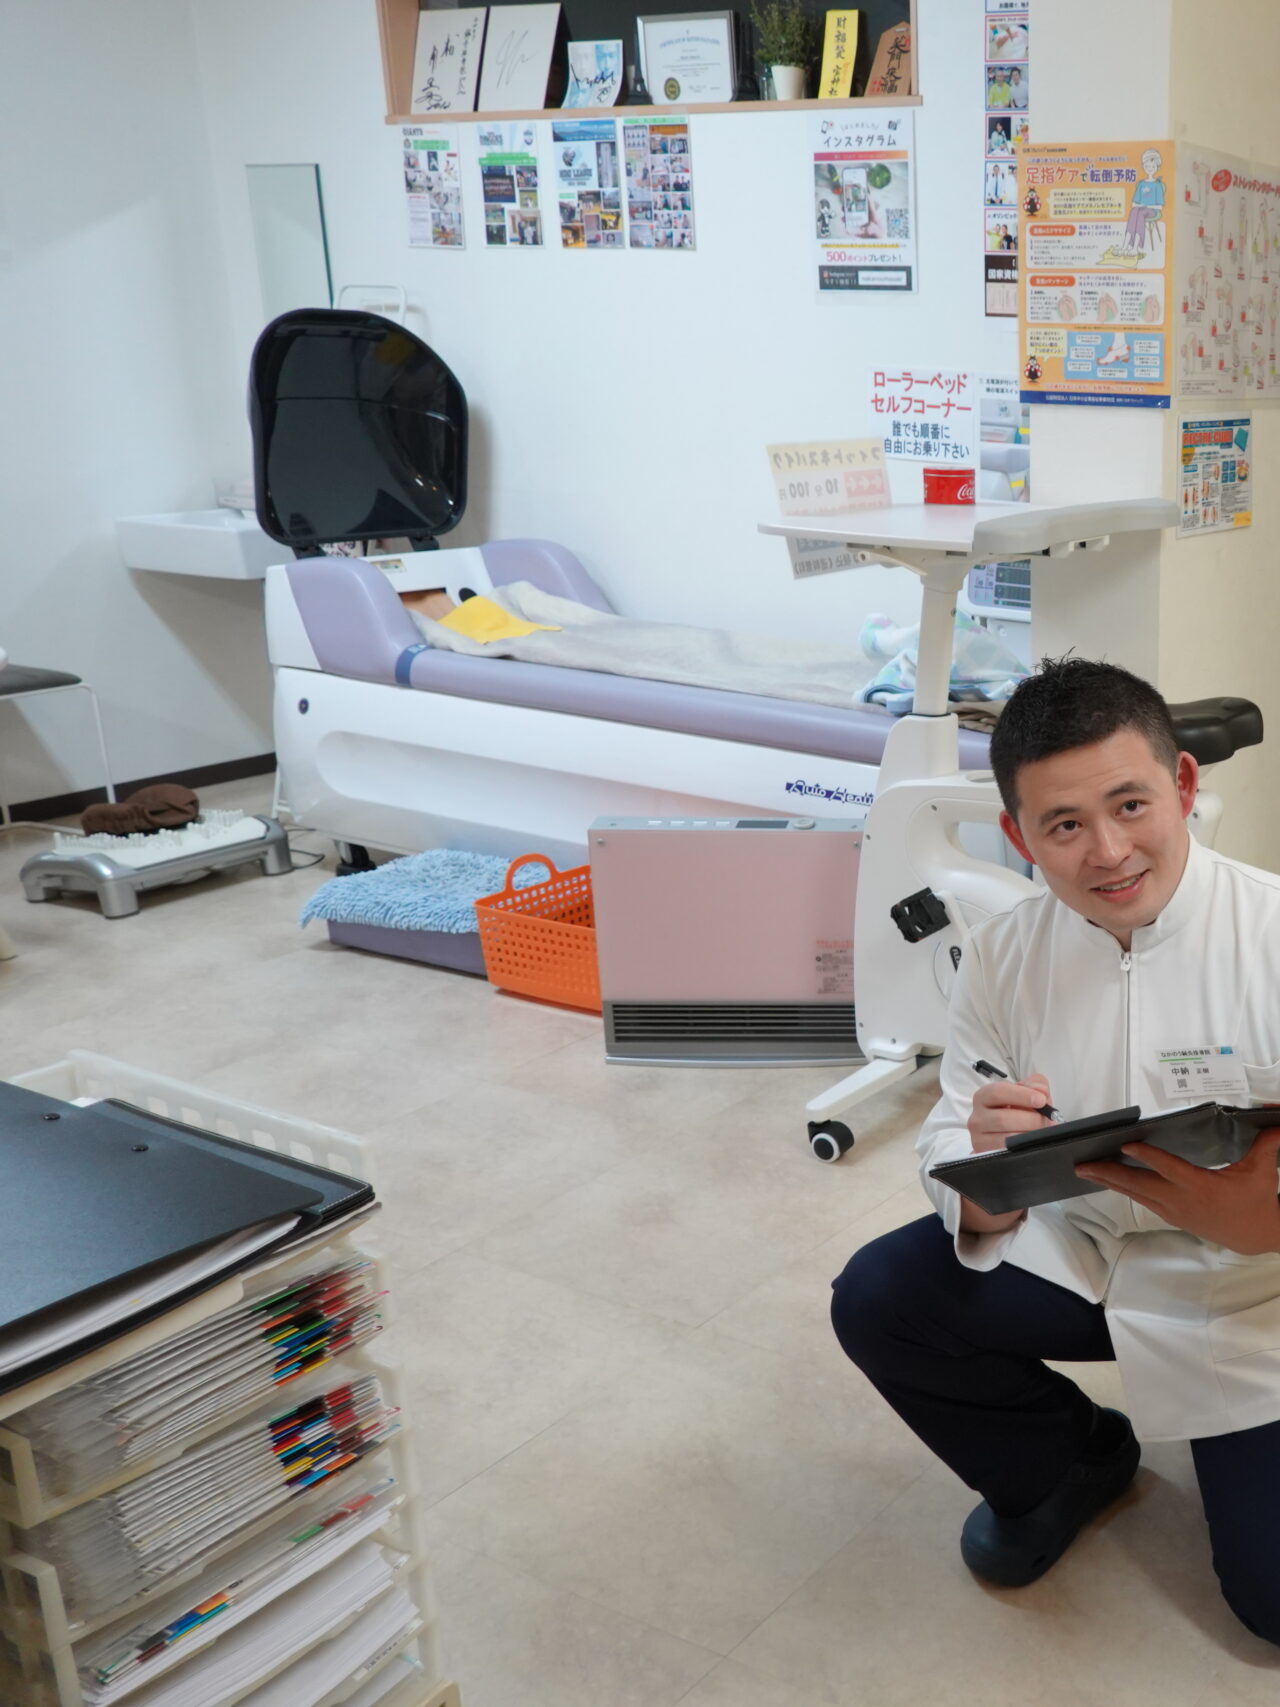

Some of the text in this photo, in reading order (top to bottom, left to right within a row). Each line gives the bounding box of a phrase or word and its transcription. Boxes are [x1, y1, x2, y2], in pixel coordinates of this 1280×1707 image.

[824, 134, 896, 148] インスタグラム
[1026, 166, 1137, 185] 足指ケアで転倒予防
[874, 371, 968, 395] ローラーベッド
[871, 393, 972, 418] セルフコーナー
[892, 420, 951, 441] 誰でも順番に
[884, 439, 969, 460] 自由にお乗り下さい
